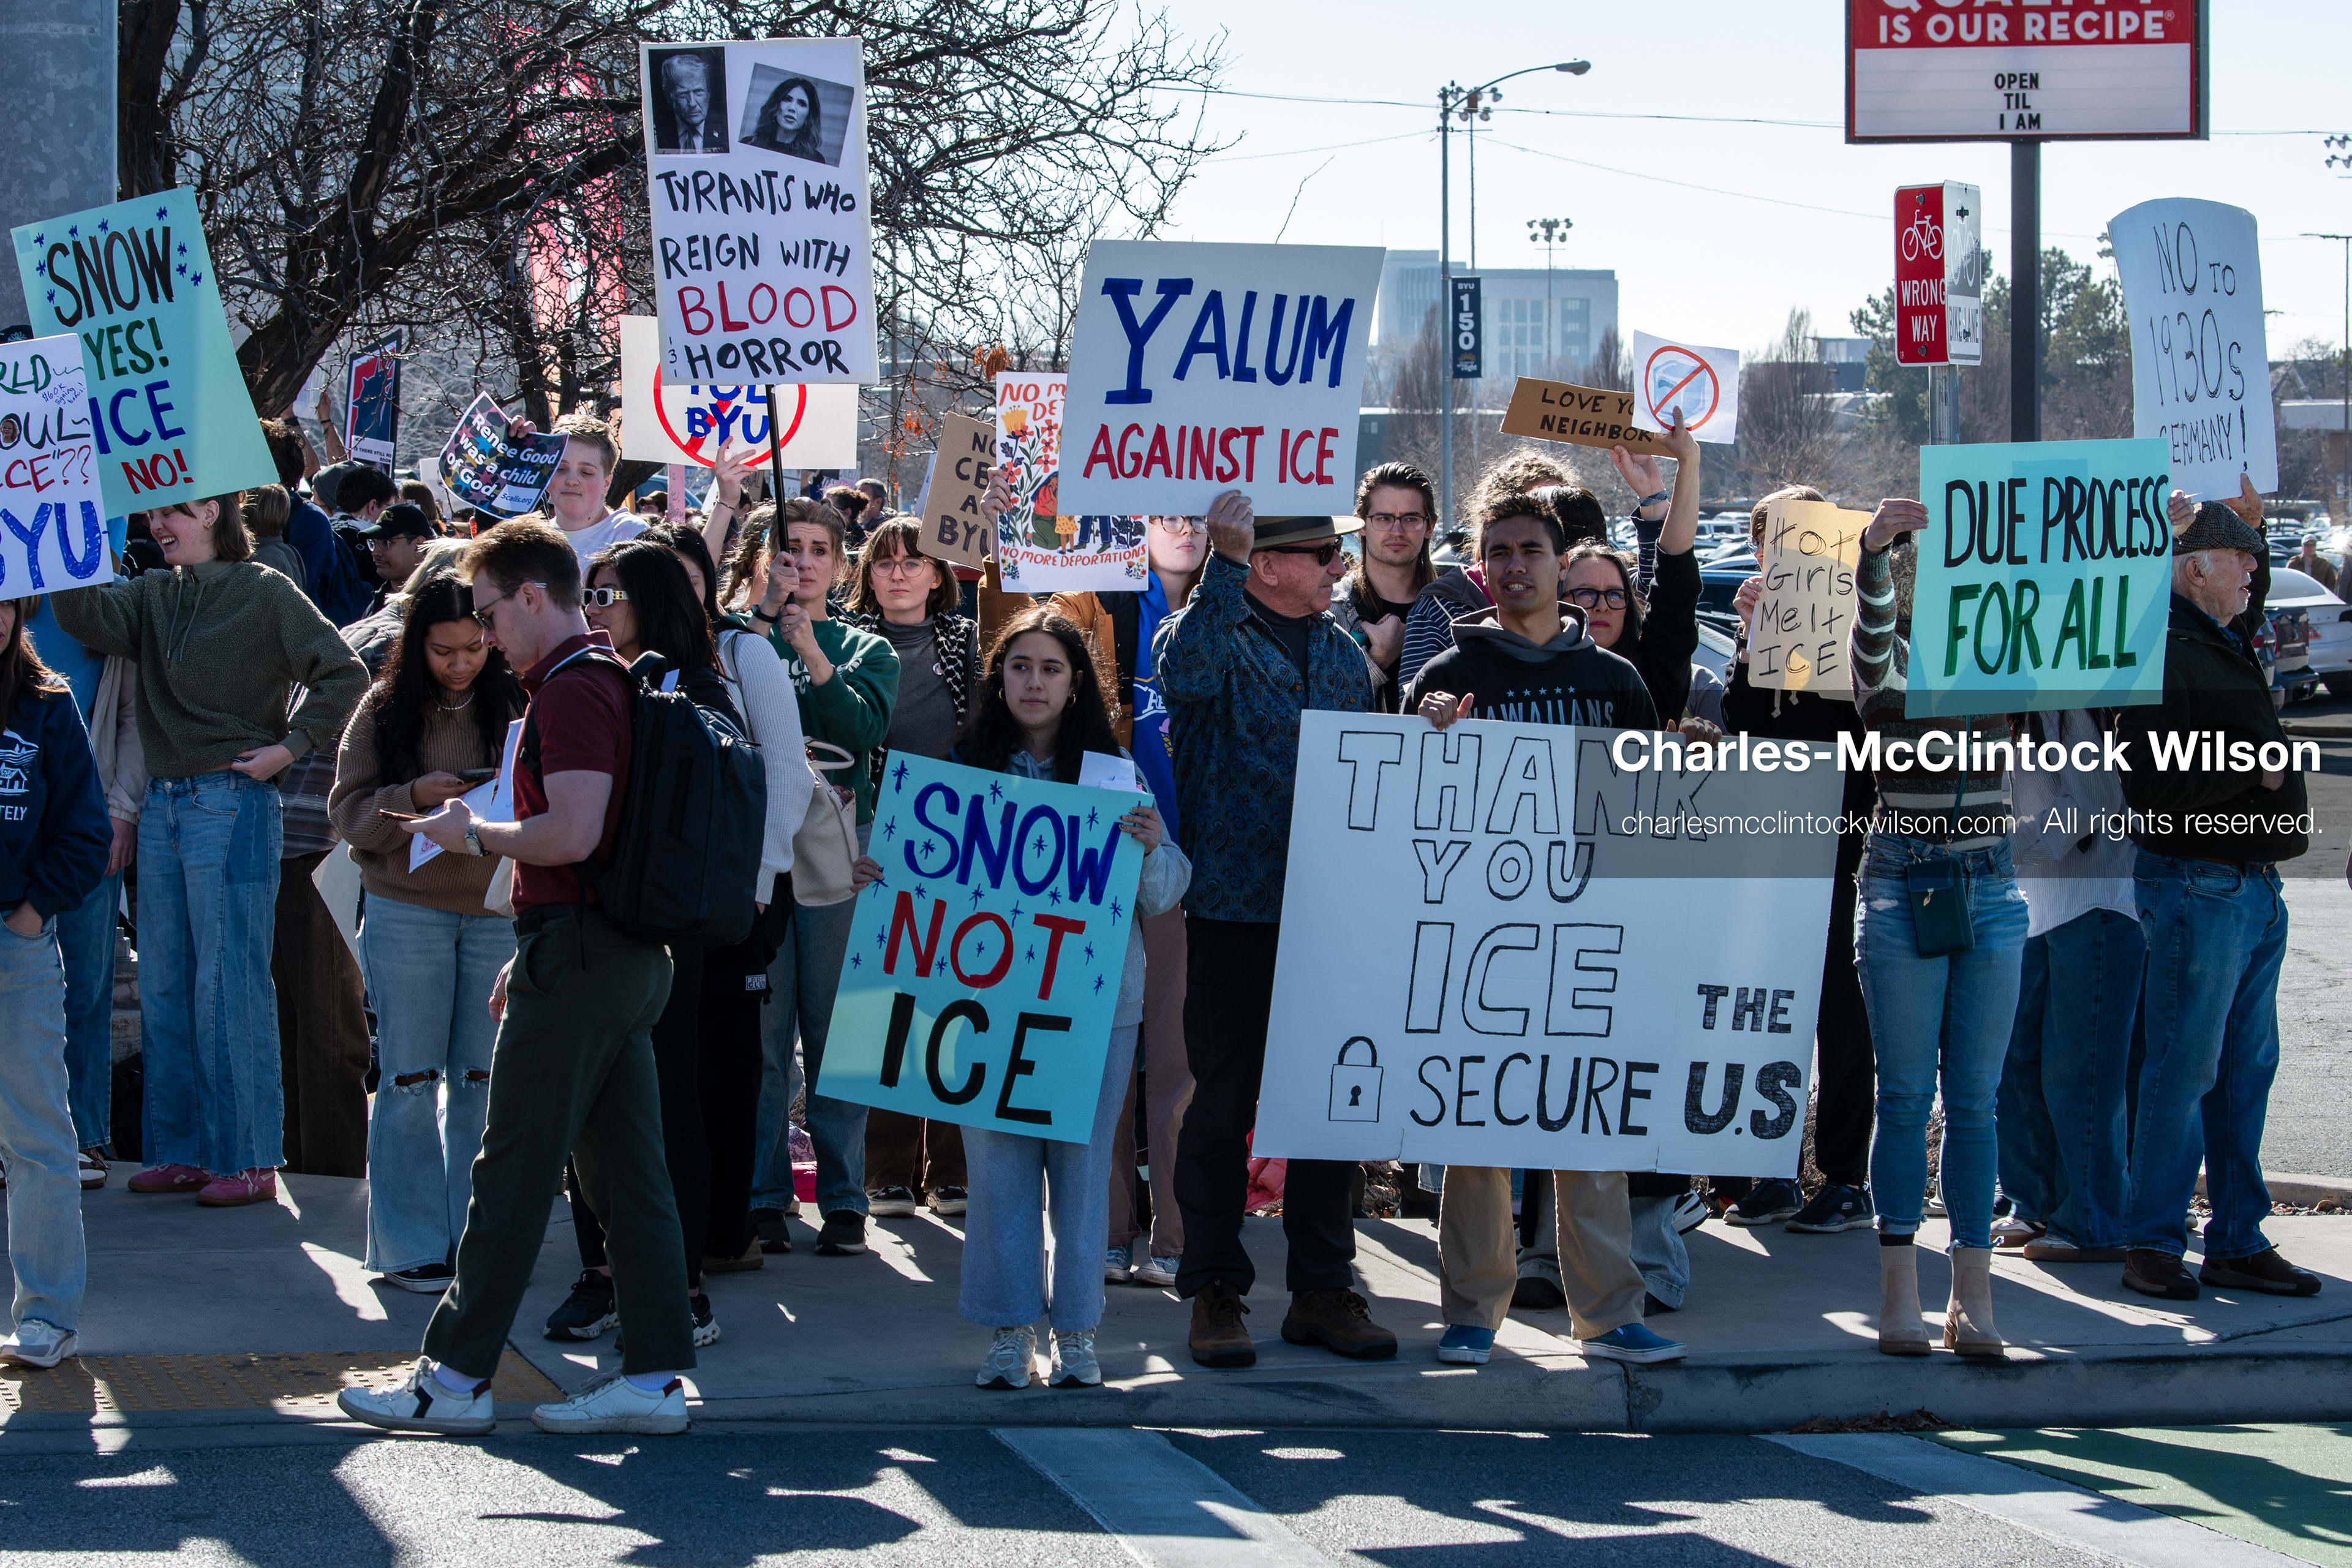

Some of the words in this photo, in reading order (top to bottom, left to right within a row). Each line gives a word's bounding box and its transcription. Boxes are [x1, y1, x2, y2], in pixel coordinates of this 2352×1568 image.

[1879, 15, 1912, 43] IS
[1926, 12, 2008, 42] OUR
[1994, 73, 2038, 89] OPEN
[2003, 92, 2031, 110] TIL
[2015, 113, 2041, 129] AM
[655, 170, 795, 216] TYRANTS
[804, 179, 856, 216] WHO
[47, 225, 174, 328] SNOW
[659, 233, 760, 280] REIGN
[780, 238, 851, 277] WITH
[2153, 221, 2198, 296] NO
[2209, 261, 2236, 296] TO
[677, 281, 857, 336] BLOOD
[1901, 277, 1946, 307] WRONG
[1101, 277, 1355, 405] YALUM
[1458, 293, 1476, 351] 150
[1911, 314, 1938, 342] WAY
[1949, 306, 1962, 342] BIKE
[1964, 307, 1979, 344] LANE
[83, 317, 170, 381] YES!
[684, 337, 850, 379] HORROR
[88, 379, 186, 454] ICE
[999, 383, 1039, 407] NO
[1033, 399, 1066, 421] DE
[1541, 388, 1606, 413] LOVE
[471, 413, 518, 458] Renee
[519, 447, 560, 465] Good
[685, 402, 770, 449] BYU
[1540, 414, 1653, 442] NEIGHBOR
[0, 445, 92, 493] CE"??
[120, 448, 195, 494] NO!
[447, 452, 465, 470] of
[459, 467, 498, 497] God.
[459, 432, 487, 466] was
[486, 461, 499, 474] a
[499, 467, 540, 485] child
[1082, 422, 1265, 484] AGAINST
[1278, 427, 1339, 486] ICE
[500, 492, 532, 505] 5calls.org
[1943, 477, 2028, 568] DUE
[2040, 474, 2169, 564] PROCESS
[0, 500, 102, 590] YU
[1000, 546, 1019, 559] NO
[1020, 551, 1058, 567] MORE
[1060, 543, 1147, 568] DEPORTATIONS
[1766, 562, 1854, 597] Girls
[1760, 598, 1844, 635] Melt
[1943, 578, 2043, 677] FOR
[2051, 575, 2137, 671] ALL
[1758, 640, 1838, 677] ICE
[1338, 730, 1721, 842] THANK
[903, 782, 1125, 907] SNOW
[1412, 839, 1595, 904] YOU
[882, 890, 1087, 1001] NOT
[1404, 920, 1624, 1038] ICE
[1697, 983, 1796, 1035] THE
[879, 992, 1072, 1126] ICE
[1409, 1054, 1660, 1136] SECURE
[1683, 1060, 1803, 1140] U.S
